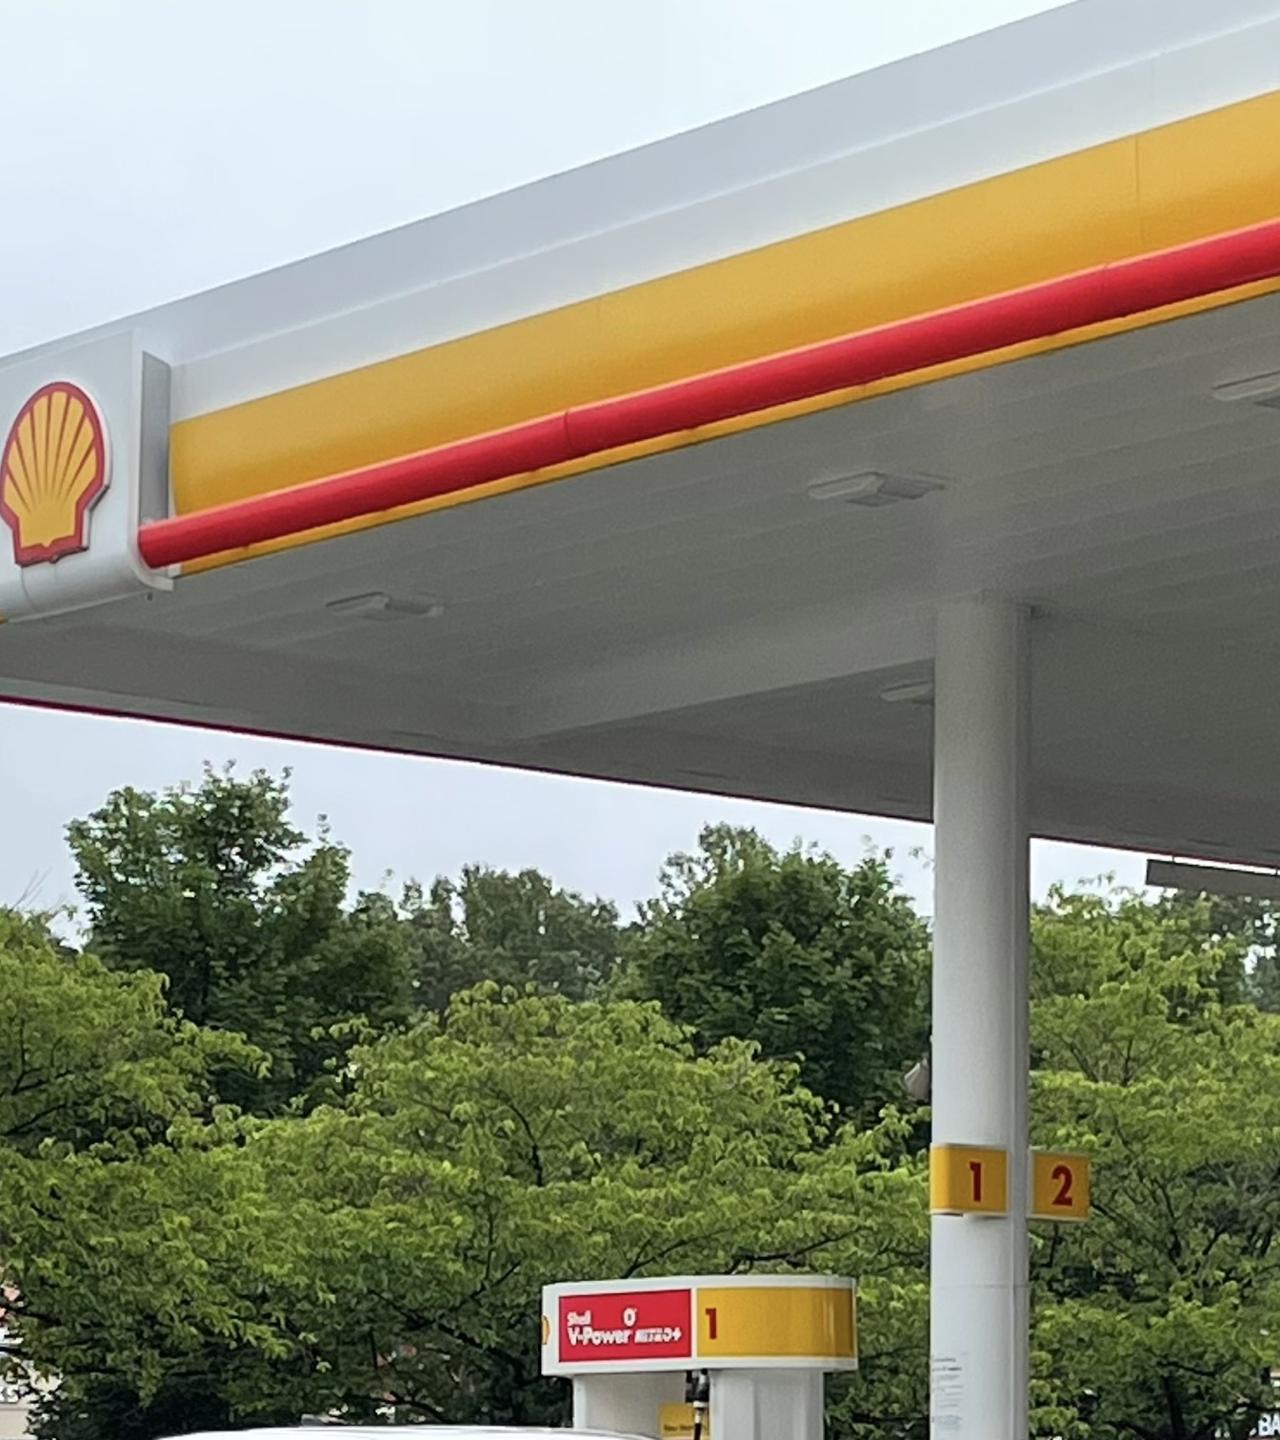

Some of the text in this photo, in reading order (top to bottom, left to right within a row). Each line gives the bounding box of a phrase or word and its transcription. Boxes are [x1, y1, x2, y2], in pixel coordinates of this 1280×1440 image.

[969, 1161, 982, 1203] 1
[1051, 1164, 1073, 1206] 2
[567, 1311, 591, 1326] Shell
[705, 1308, 718, 1340] 1
[567, 1327, 632, 1346] V-Power
